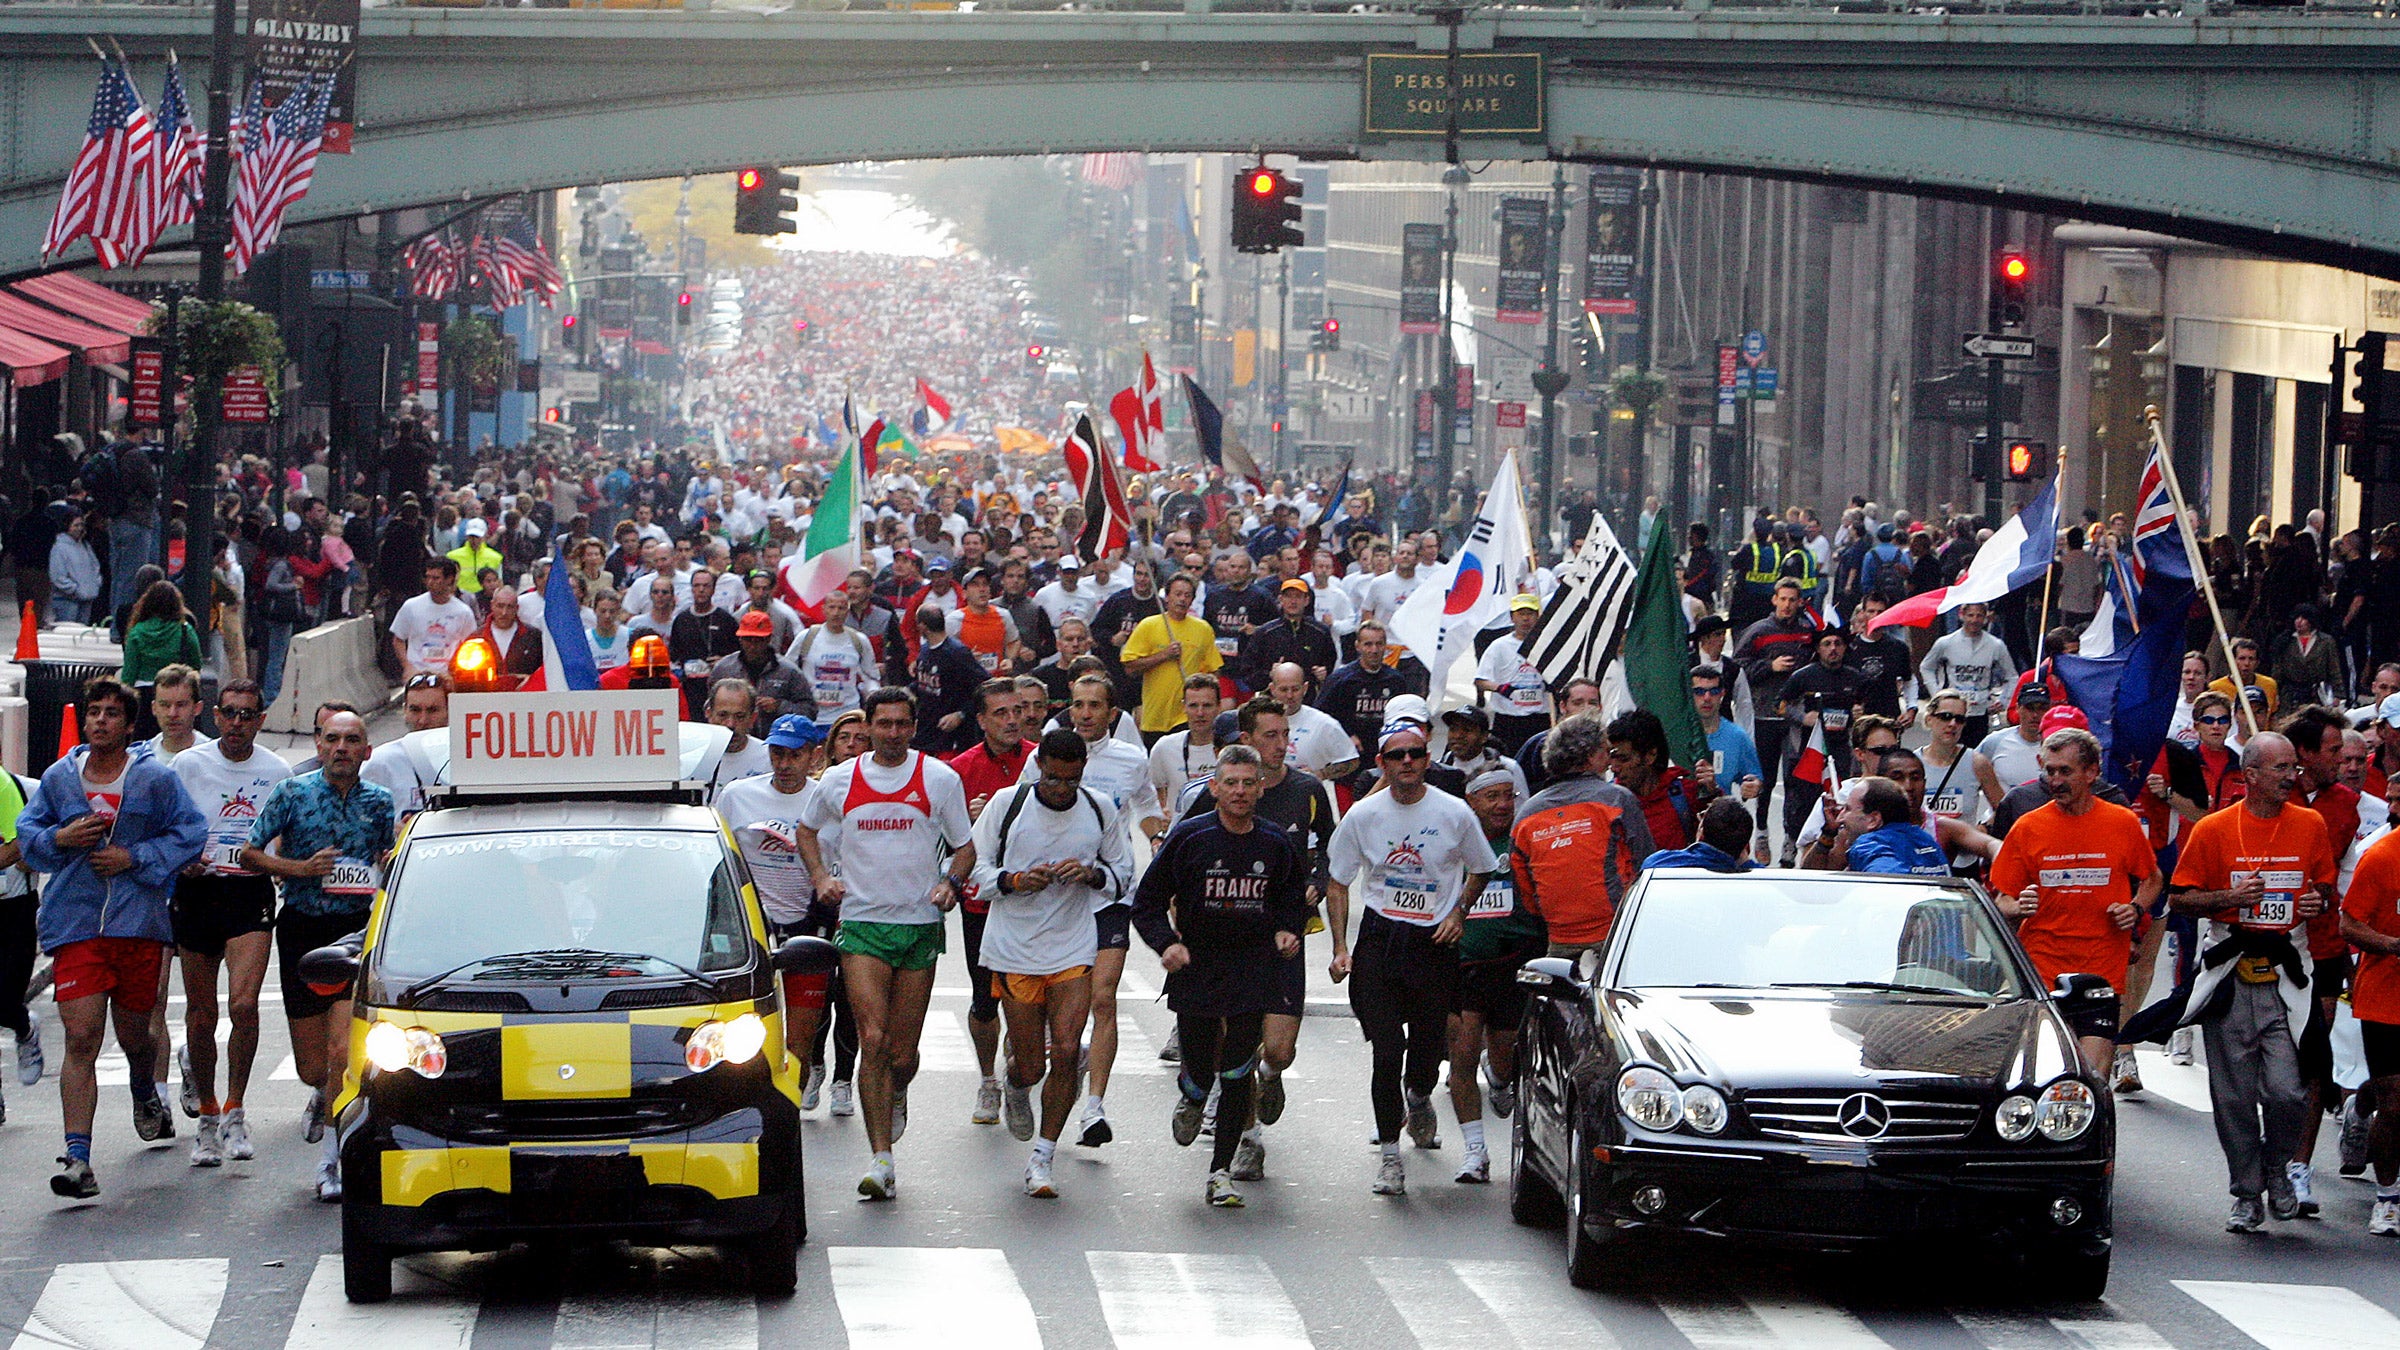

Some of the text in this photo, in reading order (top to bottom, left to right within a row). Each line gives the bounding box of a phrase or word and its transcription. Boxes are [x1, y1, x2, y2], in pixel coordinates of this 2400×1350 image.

[254, 18, 353, 43] SLAVERY
[1394, 73, 1516, 88] PERSHING
[1406, 98, 1501, 113] SQUARE
[1356, 698, 1390, 712] FRAN
[465, 709, 666, 760] FOLLOW ME
[857, 818, 915, 831] HUNGARY
[415, 830, 719, 861] www.smart.com
[1205, 878, 1268, 898] FRANCE
[1393, 890, 1426, 911] 4280
[2247, 903, 2286, 920] 1439
